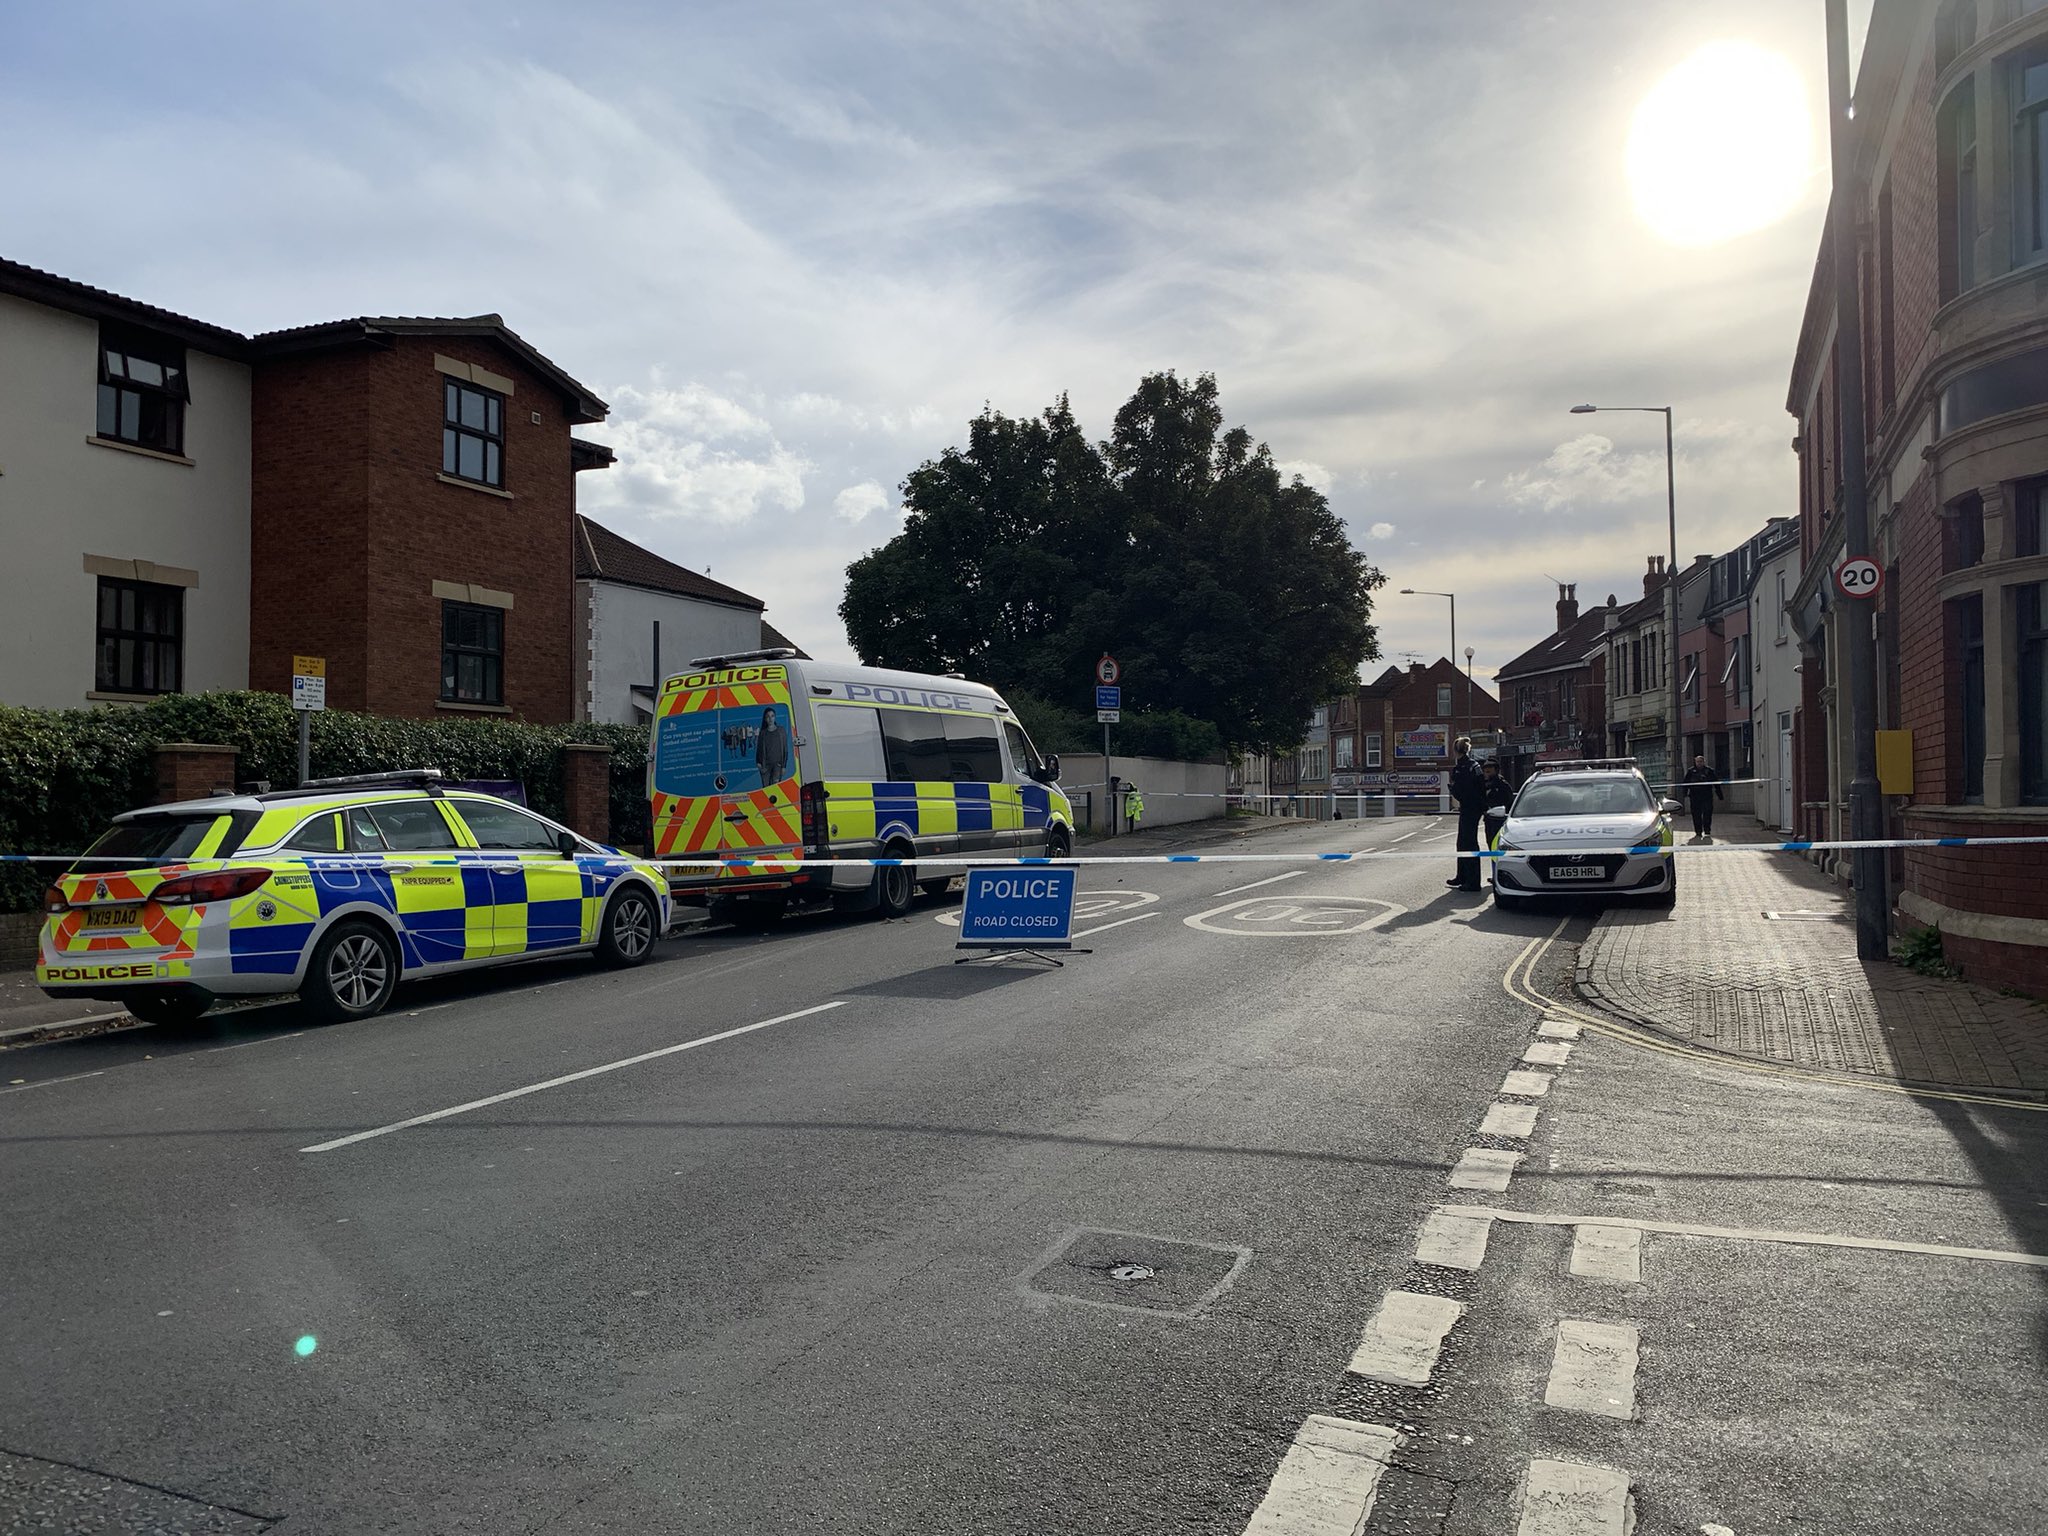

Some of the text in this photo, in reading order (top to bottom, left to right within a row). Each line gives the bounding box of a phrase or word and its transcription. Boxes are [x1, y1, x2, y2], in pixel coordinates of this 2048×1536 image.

[1843, 567, 1877, 587] 20
[665, 666, 783, 693] POLICE
[844, 684, 973, 711] POLICE
[1536, 827, 1616, 837] POLICE
[419, 877, 446, 885] EQUIPPED
[1552, 867, 1600, 878] EA69 HRL
[980, 879, 1060, 899] POLICE
[87, 909, 137, 927] WX19 DAO
[974, 916, 1059, 927] ROAD CLOSED
[46, 964, 154, 981] POLICE
